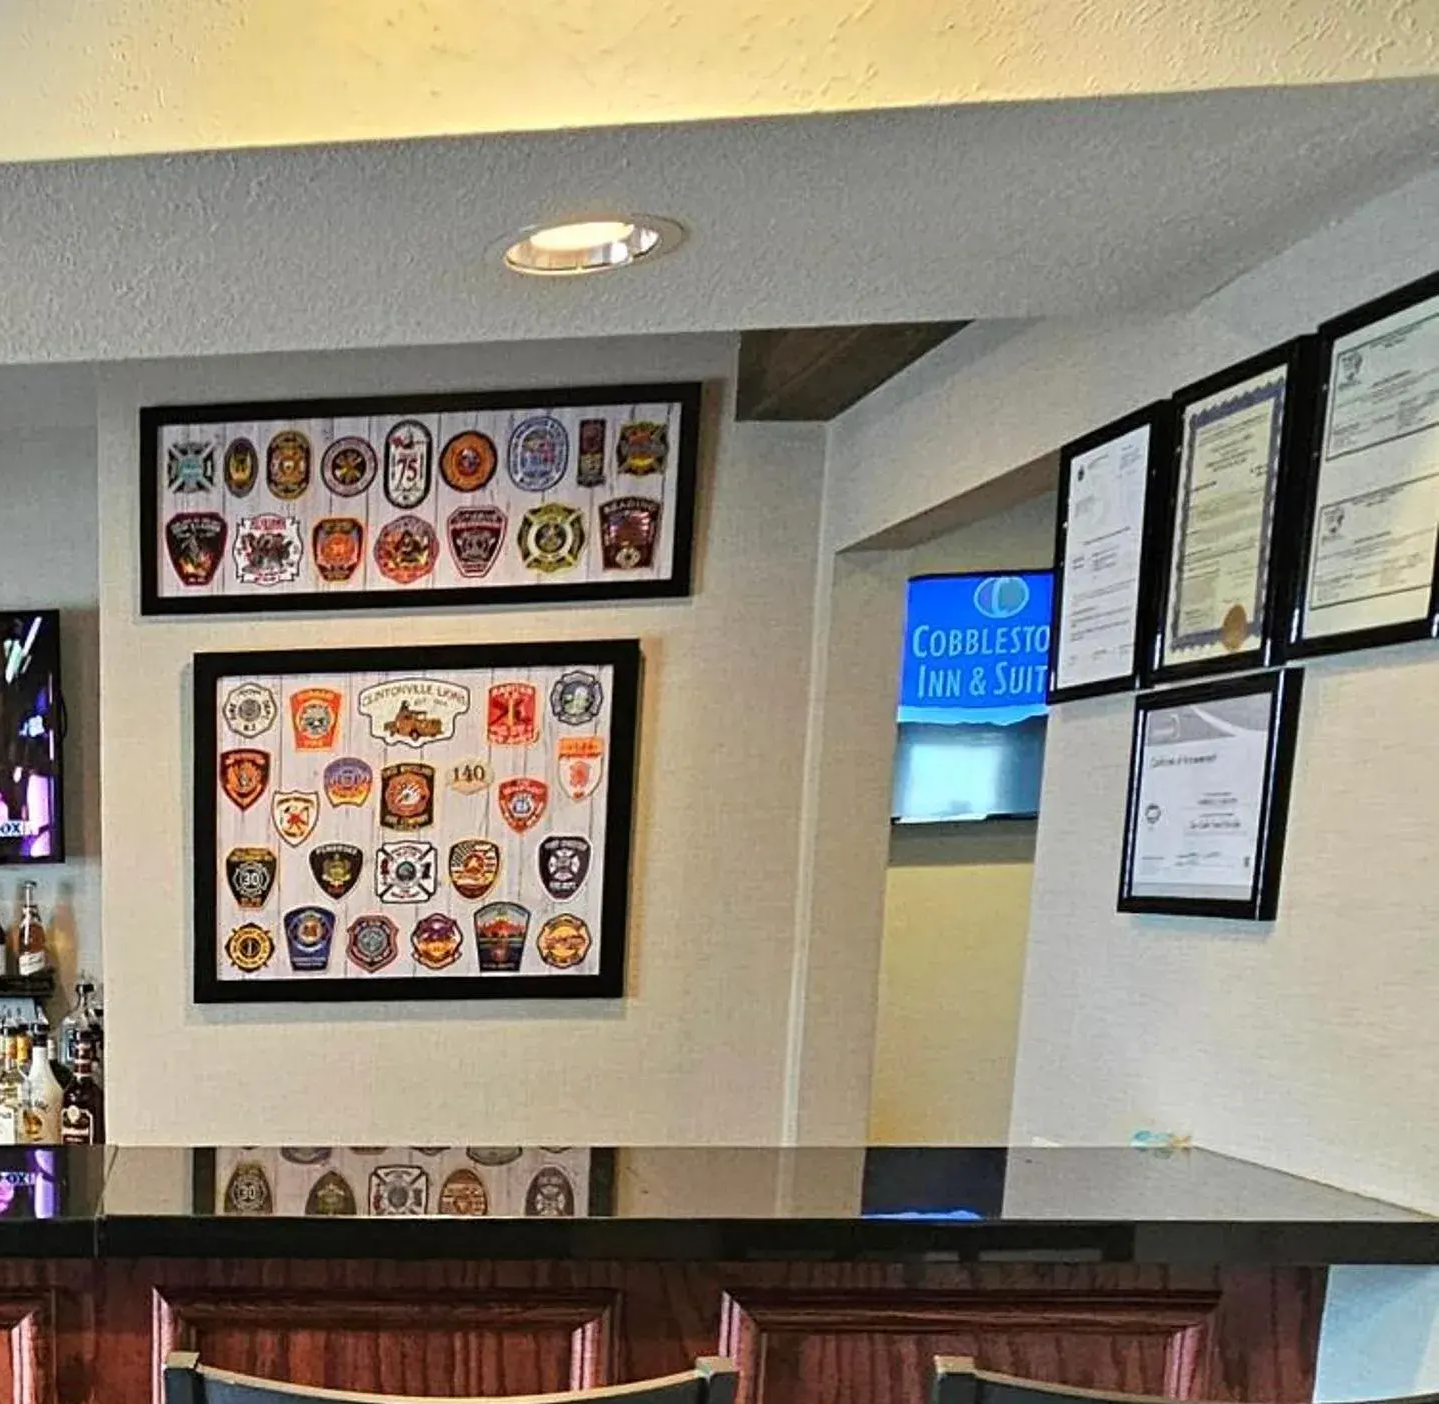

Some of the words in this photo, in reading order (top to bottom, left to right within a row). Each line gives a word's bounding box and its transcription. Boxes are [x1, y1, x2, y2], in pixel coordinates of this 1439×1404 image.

[396, 457, 418, 490] 75
[913, 624, 1050, 658] COBBLESTO
[917, 664, 961, 699] INN
[968, 666, 986, 696] &
[993, 661, 1048, 695] SUIT
[453, 764, 485, 783] 140
[242, 872, 260, 886] 30
